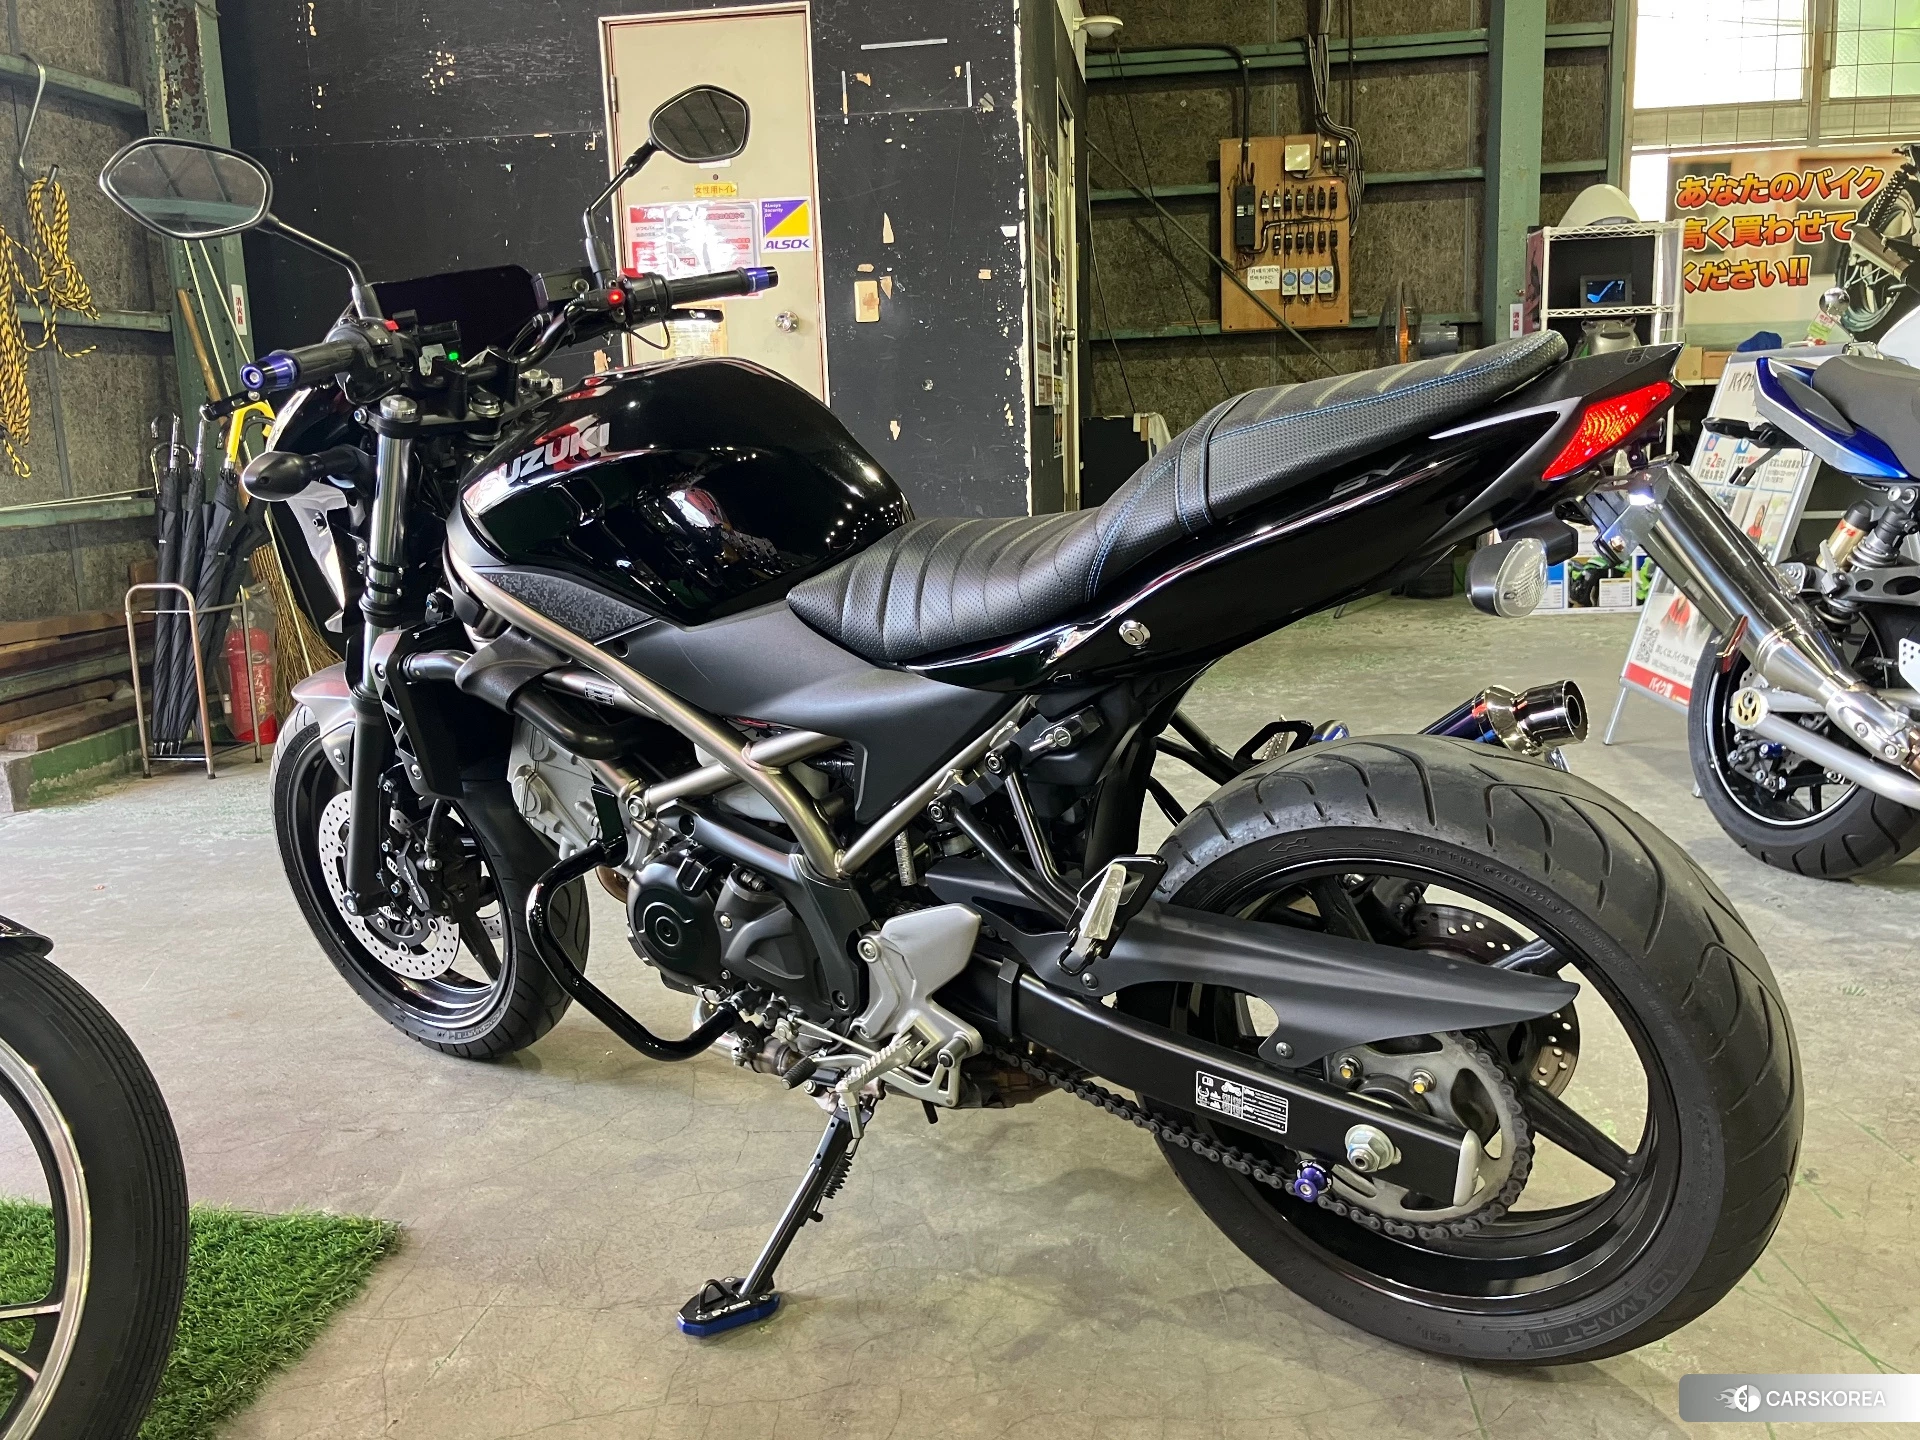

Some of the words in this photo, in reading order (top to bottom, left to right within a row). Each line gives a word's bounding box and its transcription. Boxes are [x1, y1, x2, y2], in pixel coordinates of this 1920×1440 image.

[694, 185, 736, 194] 女性用トイレ
[1677, 166, 1884, 208] あなたのバイク
[764, 239, 810, 250] ALSOK
[1684, 210, 1858, 251] 高く買わせて
[235, 296, 243, 325] 消火器
[1564, 1262, 1684, 1342] ADSMART
